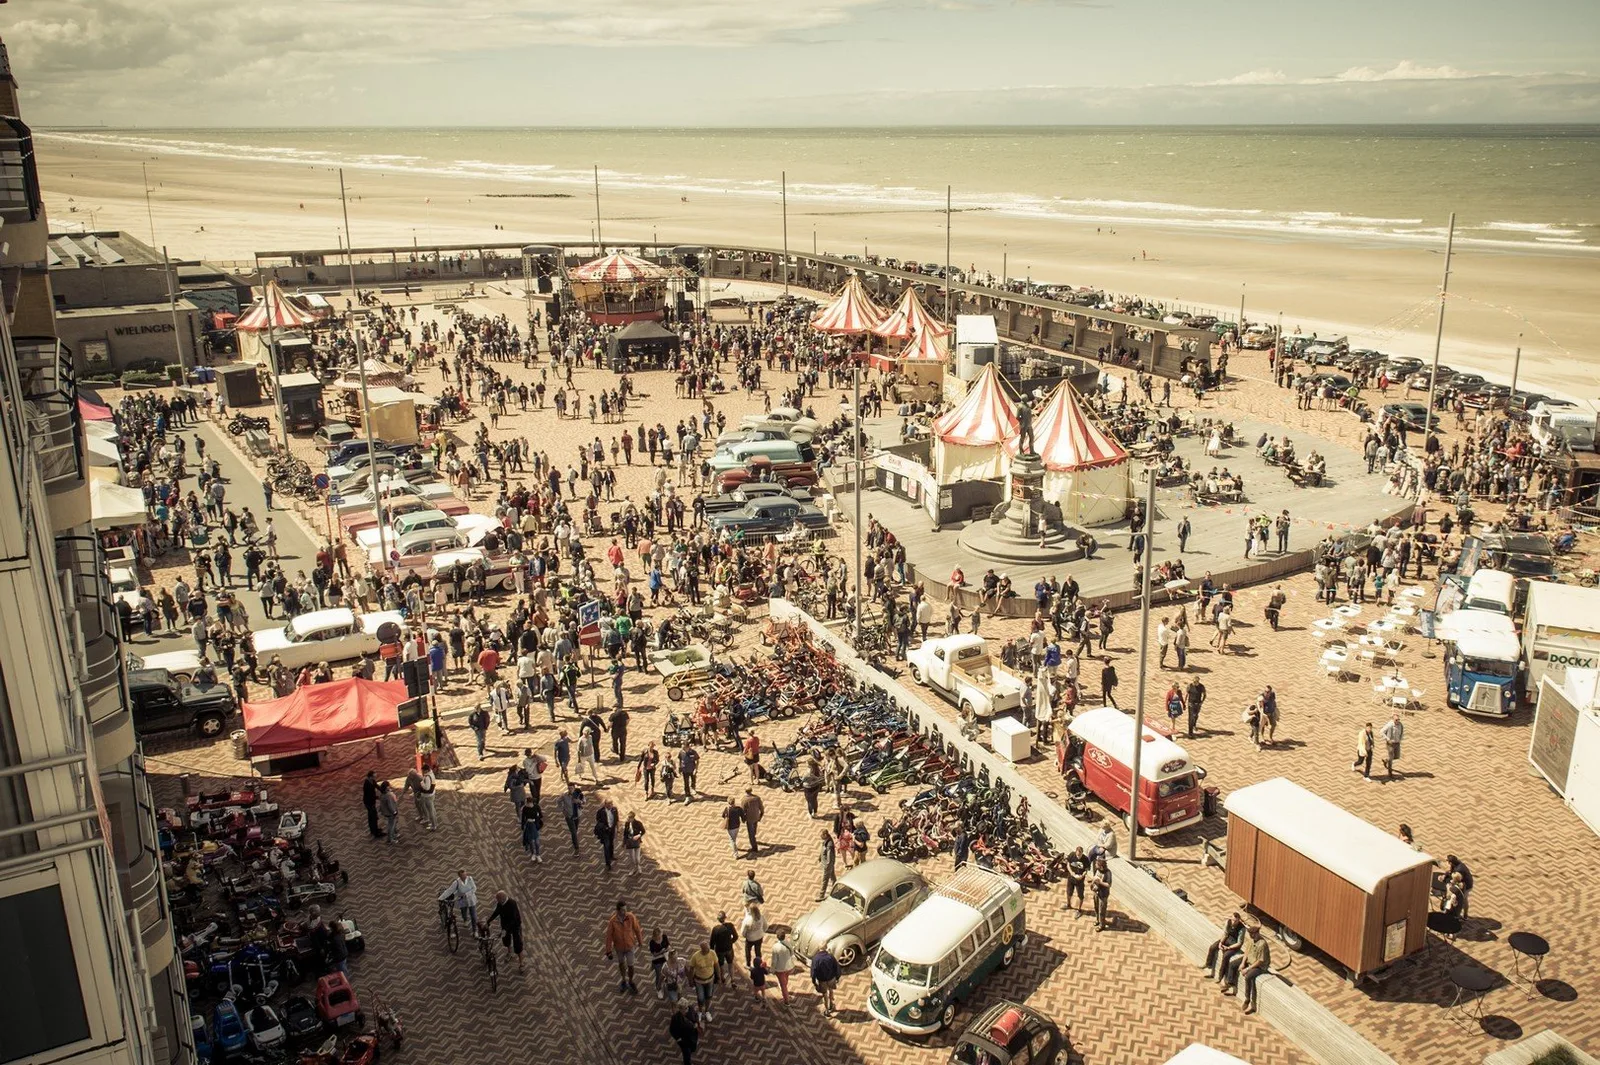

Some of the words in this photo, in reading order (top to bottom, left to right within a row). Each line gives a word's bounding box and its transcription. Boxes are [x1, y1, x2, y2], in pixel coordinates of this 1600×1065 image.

[114, 323, 176, 336] WIELINGEN
[1550, 654, 1592, 668] DOCKX
[886, 988, 900, 1005] VW
